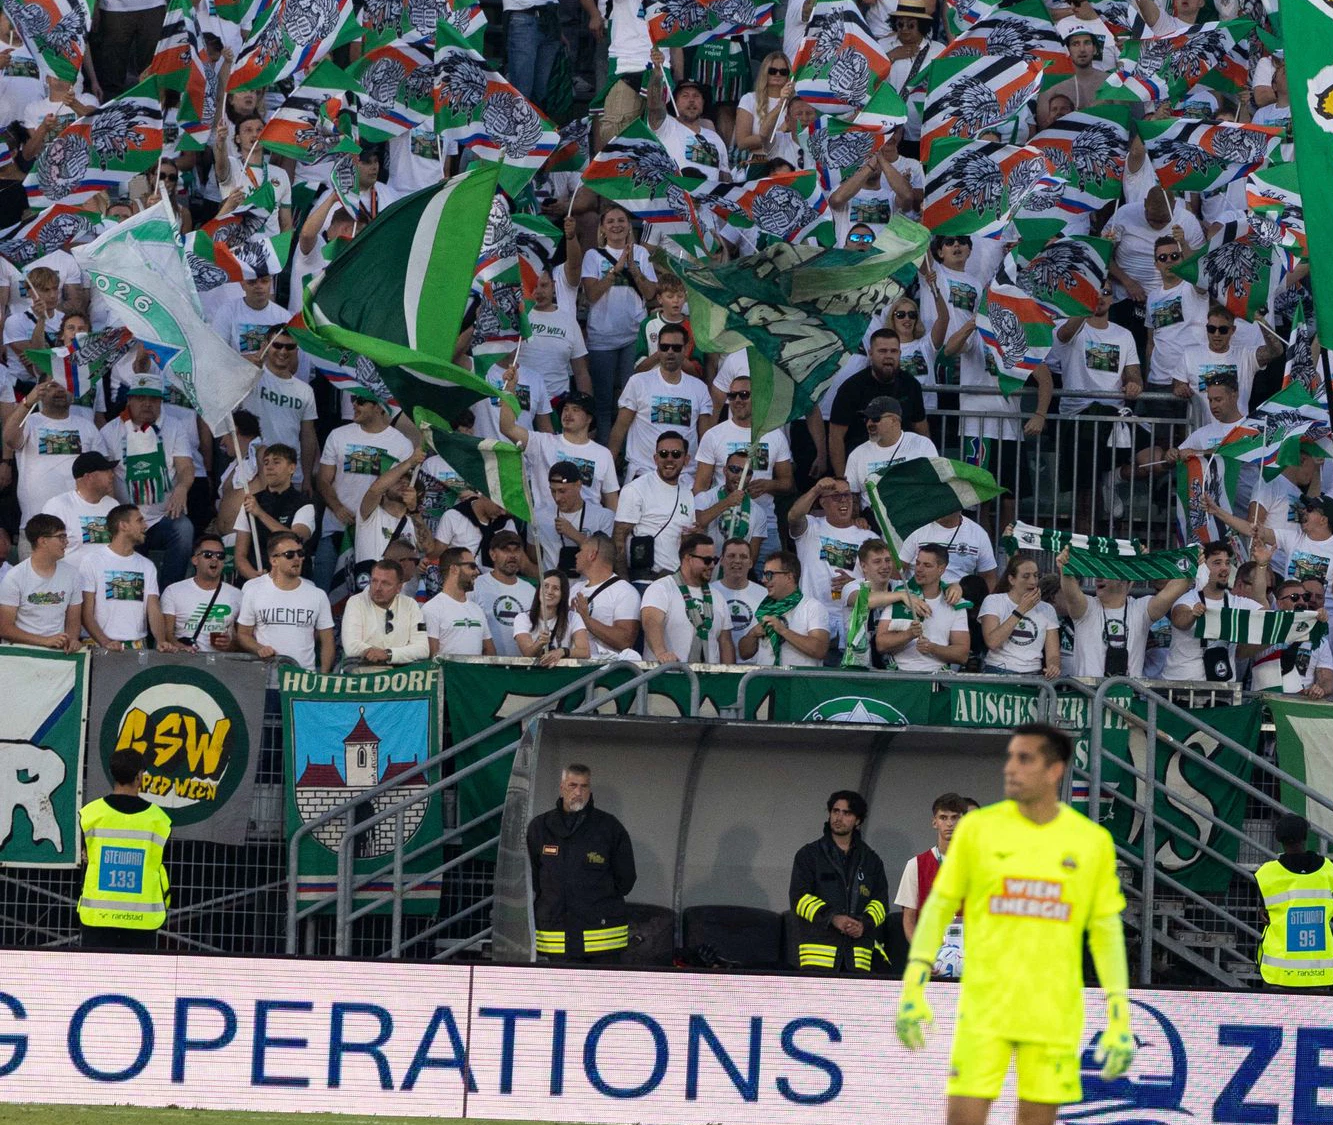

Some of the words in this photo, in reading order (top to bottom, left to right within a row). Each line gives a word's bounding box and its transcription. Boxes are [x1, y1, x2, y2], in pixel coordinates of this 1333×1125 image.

[260, 386, 303, 411] RAPID
[259, 607, 316, 626] WIENER
[282, 663, 440, 694] HÜTTELDORF
[175, 777, 216, 801] WIEN
[104, 849, 143, 866] STEWARD
[108, 871, 136, 889] 133
[1005, 878, 1062, 897] WIEN
[111, 911, 144, 922] randstad
[1299, 929, 1316, 948] 95
[1296, 968, 1325, 978] randstad
[67, 992, 844, 1106] OPERATIONS
